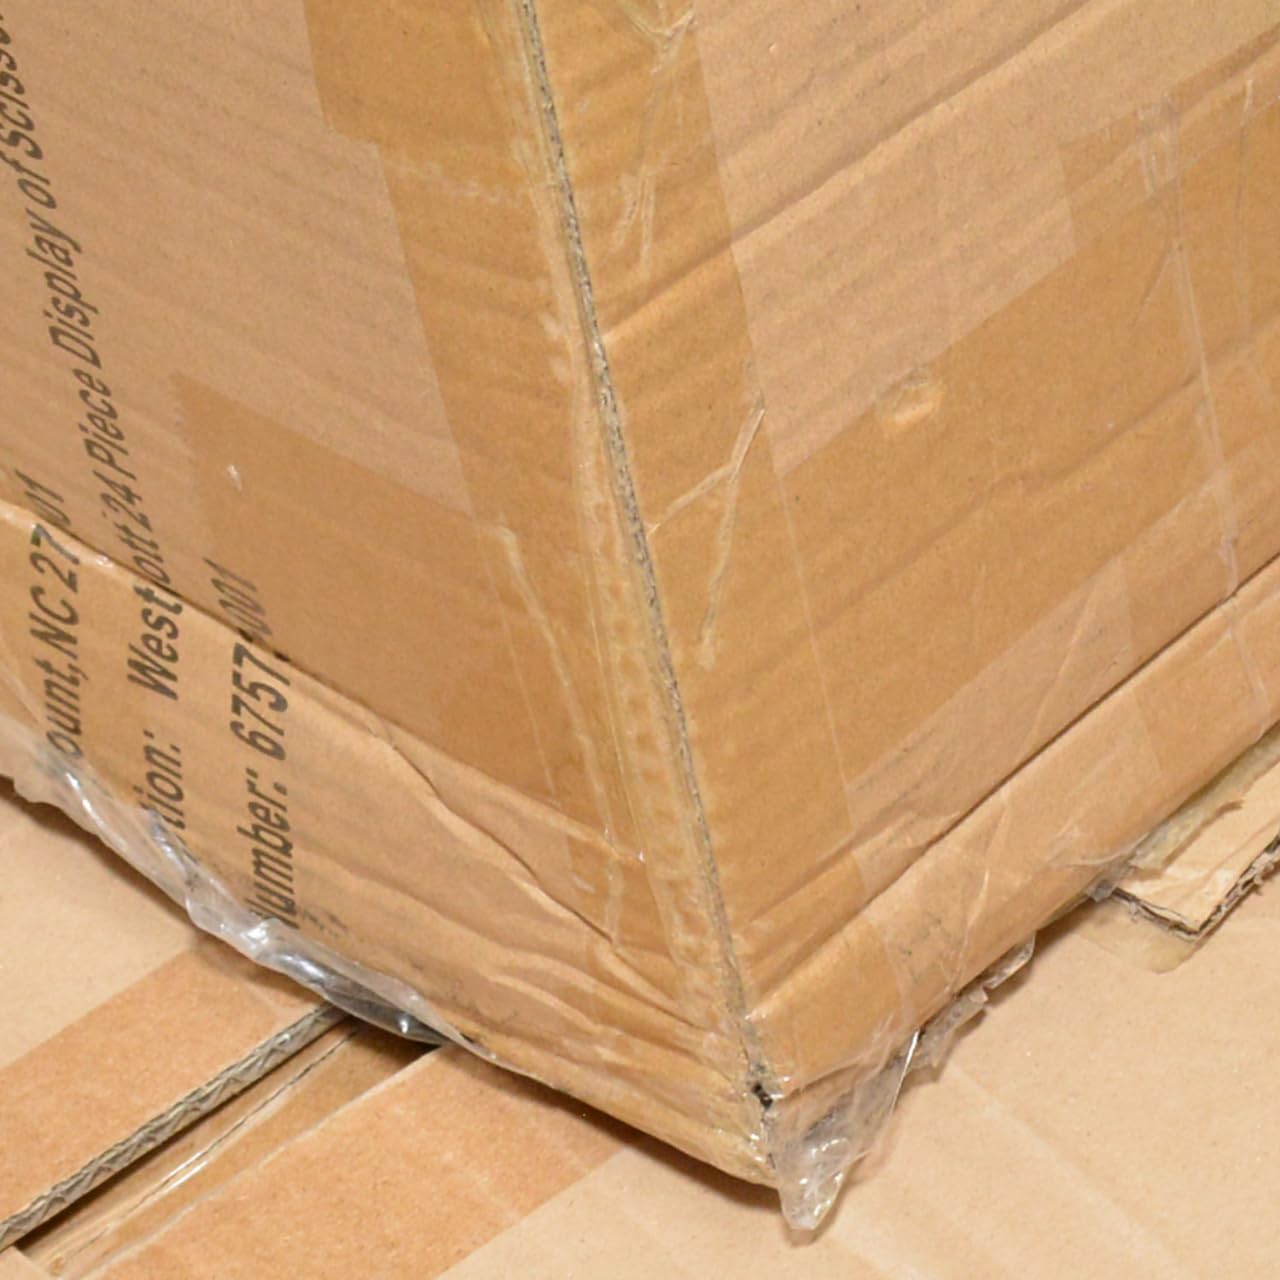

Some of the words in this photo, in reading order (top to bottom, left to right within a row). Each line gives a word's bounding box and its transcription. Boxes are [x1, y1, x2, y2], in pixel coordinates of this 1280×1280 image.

[0, 150, 57, 209] of
[26, 208, 102, 370] Display
[78, 367, 137, 481] Piece
[91, 470, 152, 532] 24
